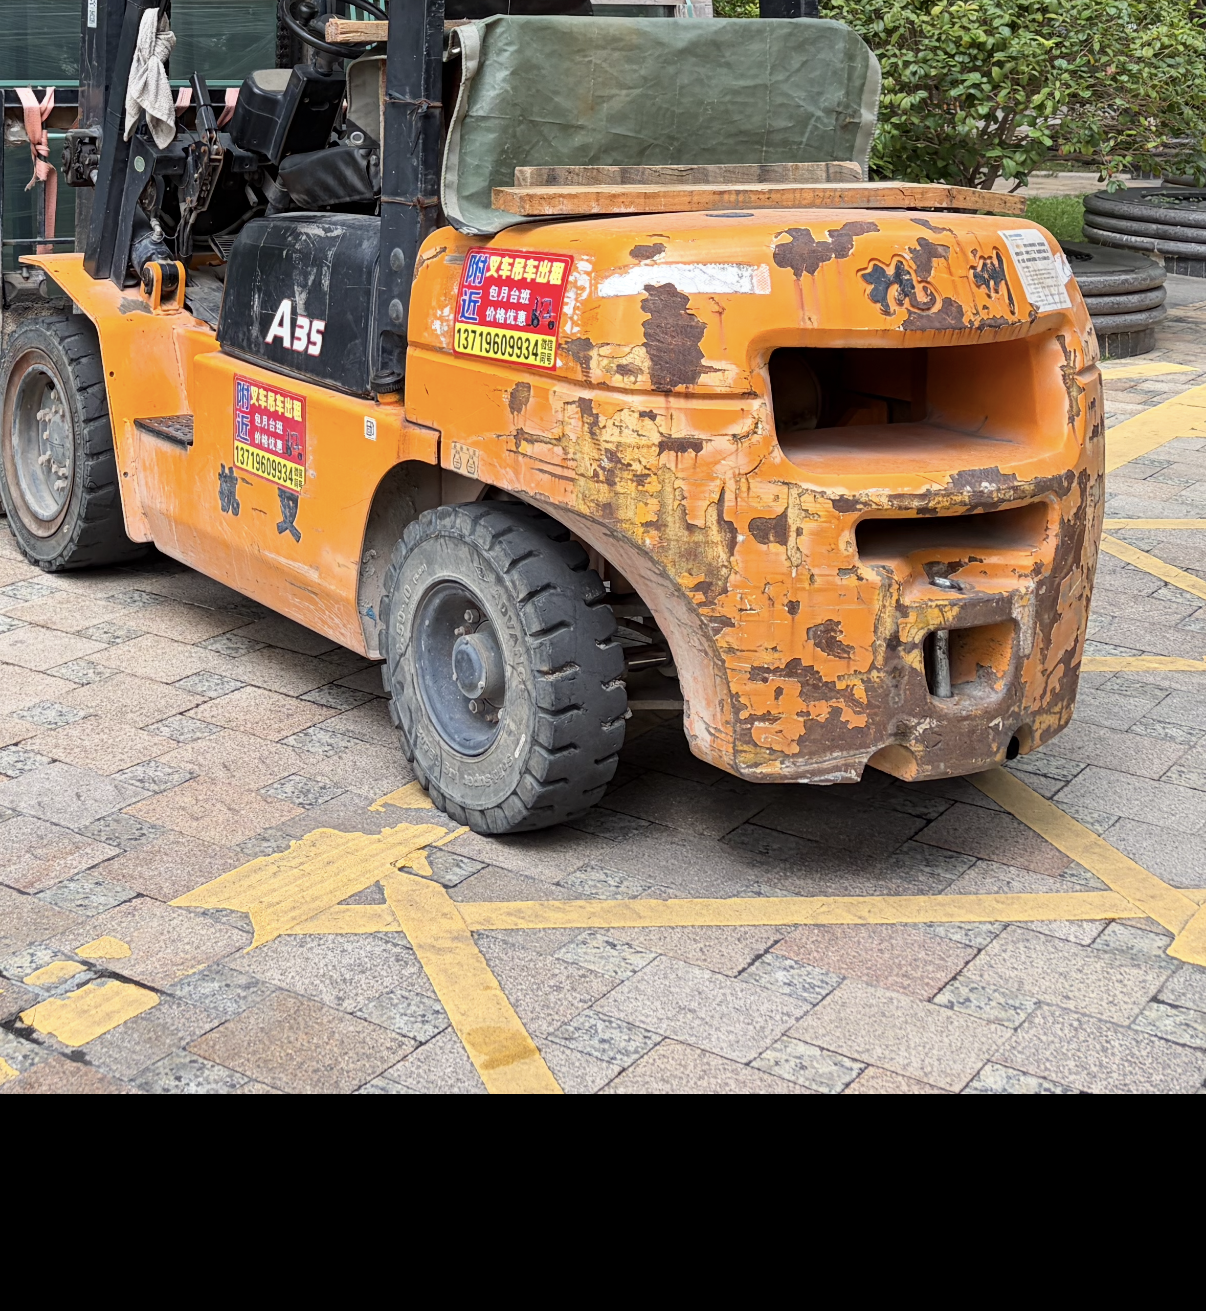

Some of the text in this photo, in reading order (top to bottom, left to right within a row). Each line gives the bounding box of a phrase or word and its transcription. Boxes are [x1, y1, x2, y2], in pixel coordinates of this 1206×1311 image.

[486, 256, 566, 285] 叉车吊车出租
[459, 254, 489, 323] 附近
[489, 285, 531, 304] 包月台班
[264, 298, 327, 357] A35
[486, 307, 527, 326] 价格优惠
[457, 328, 540, 362] 13719609934
[236, 381, 250, 444] 附近
[250, 385, 303, 422] 叉车吊车出租
[254, 412, 284, 435] 包月台班
[254, 431, 284, 454] 价格优惠
[235, 445, 294, 486] 13719609934
